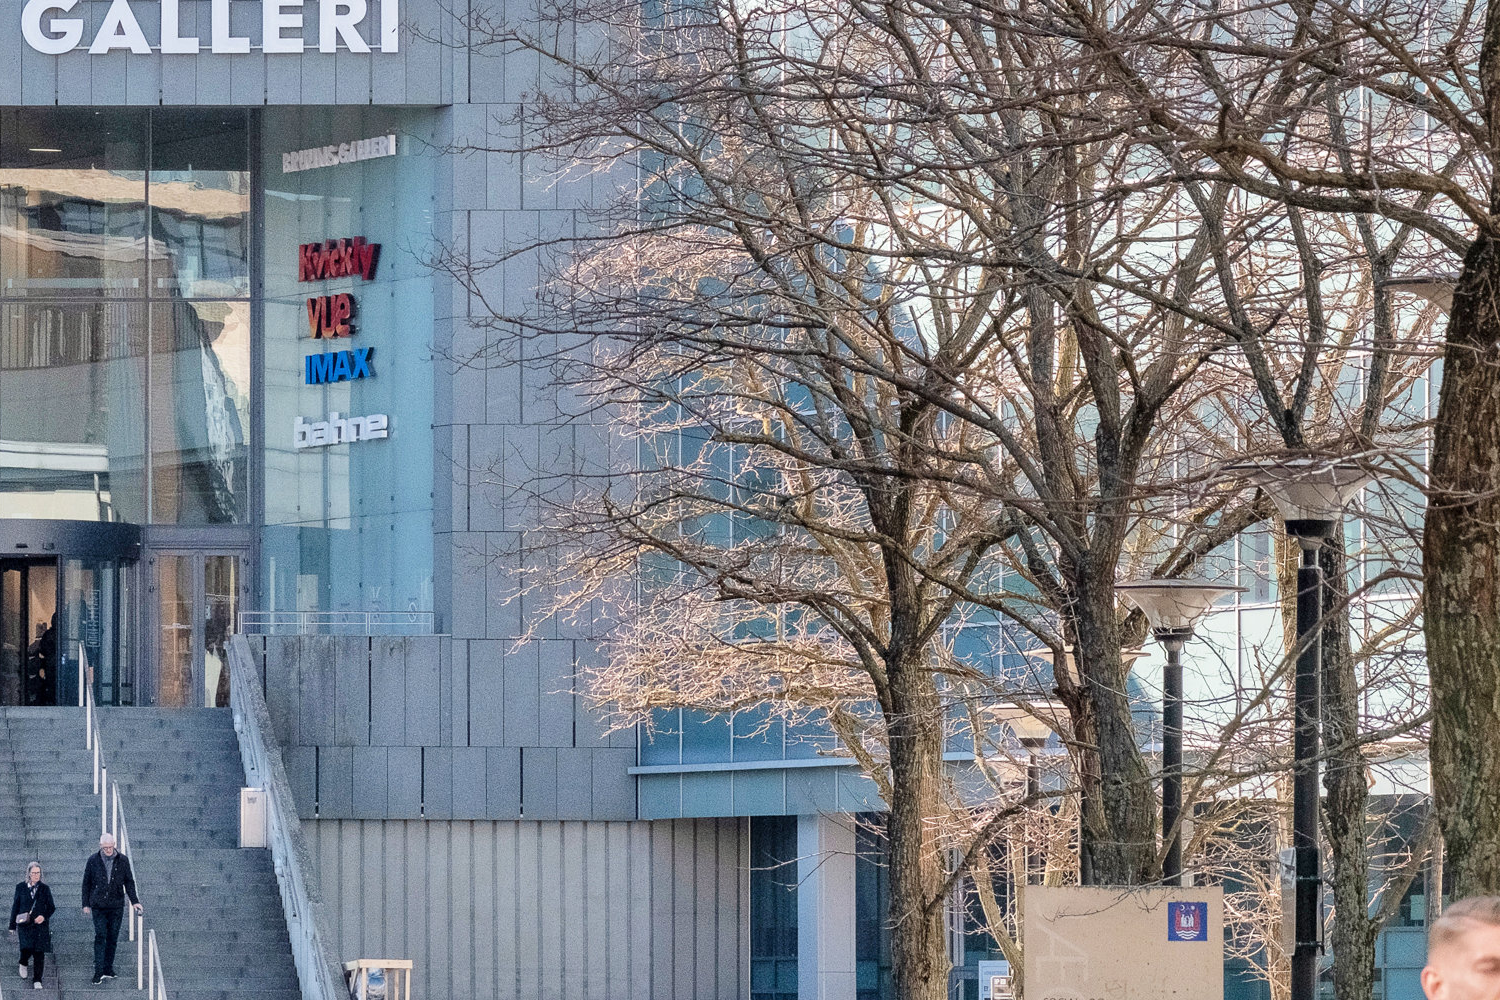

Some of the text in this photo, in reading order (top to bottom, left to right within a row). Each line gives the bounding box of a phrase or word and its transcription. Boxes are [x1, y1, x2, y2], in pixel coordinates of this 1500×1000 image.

[298, 236, 379, 282] Kvickly
[305, 347, 373, 385] IMAX
[293, 411, 388, 449] bahne
